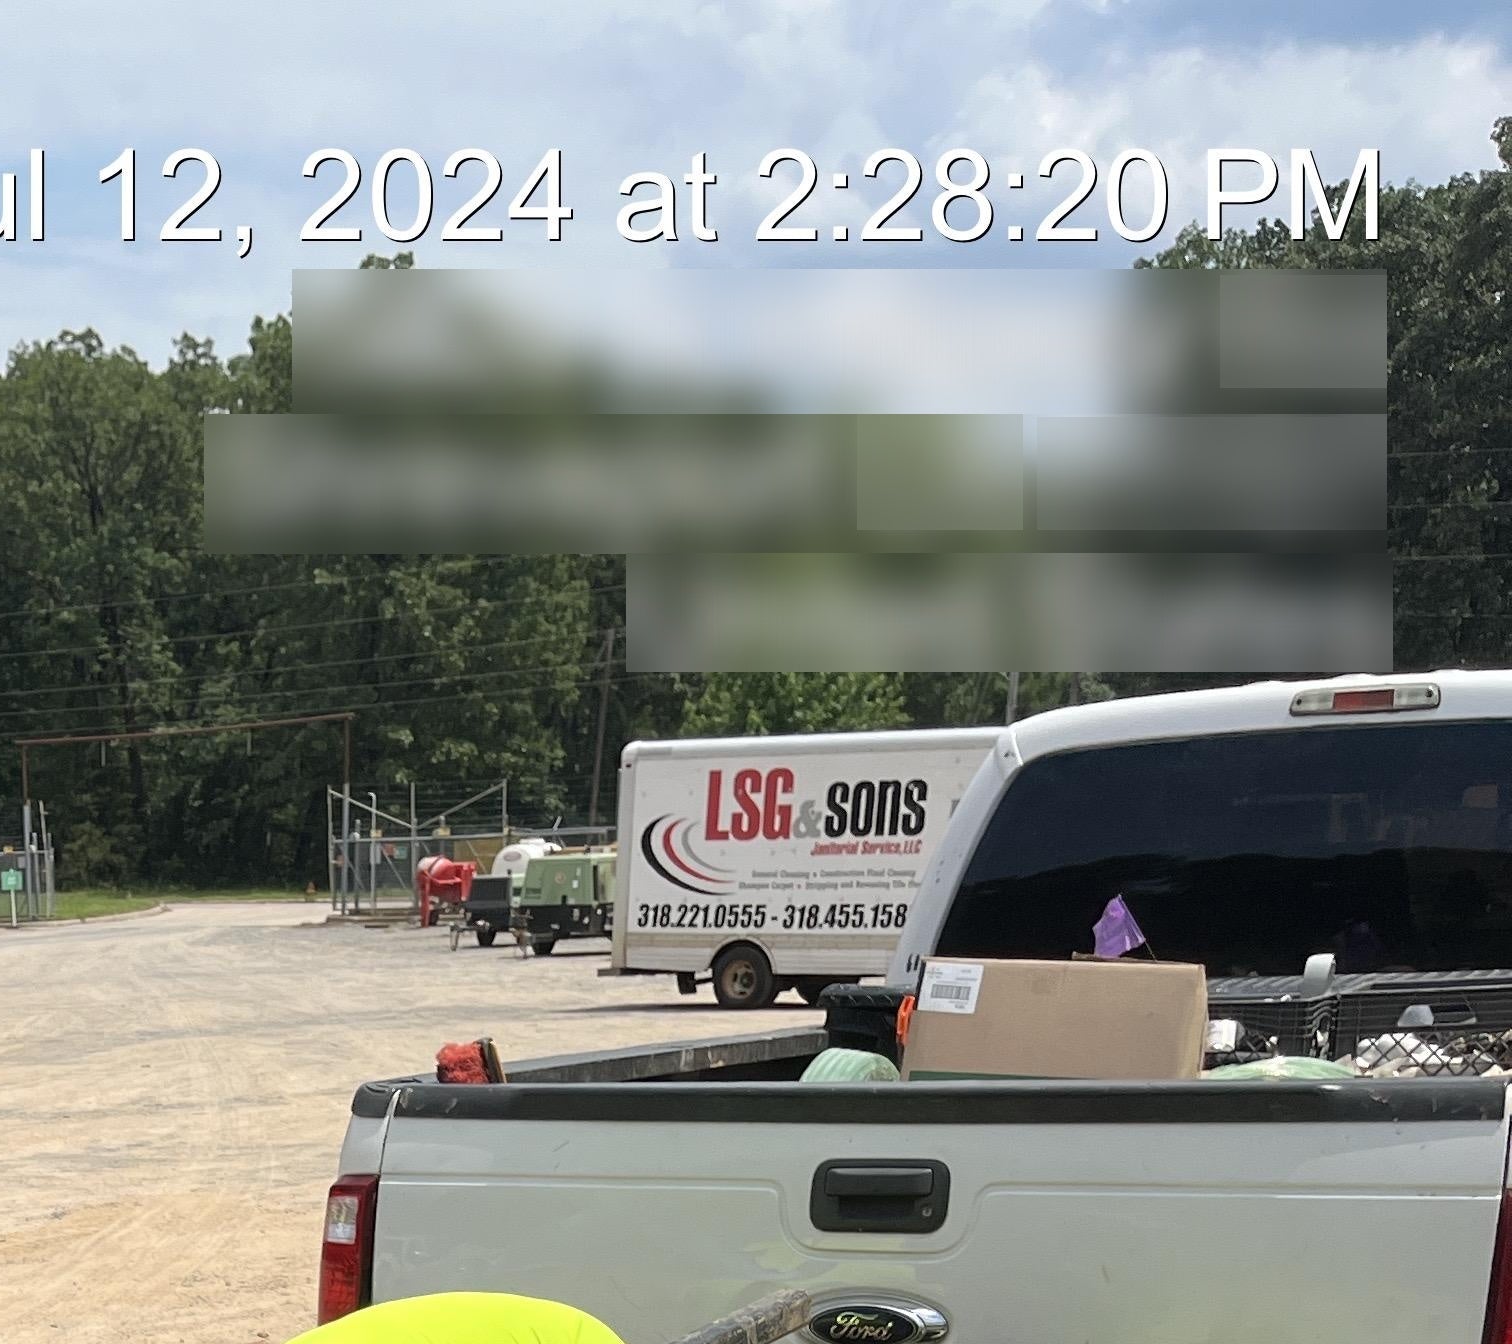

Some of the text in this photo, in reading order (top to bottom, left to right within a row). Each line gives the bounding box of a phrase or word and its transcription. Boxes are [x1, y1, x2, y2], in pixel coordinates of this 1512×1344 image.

[704, 767, 795, 841] LSG
[637, 903, 768, 929] 318.221.0555
[830, 1311, 894, 1341] Ford
